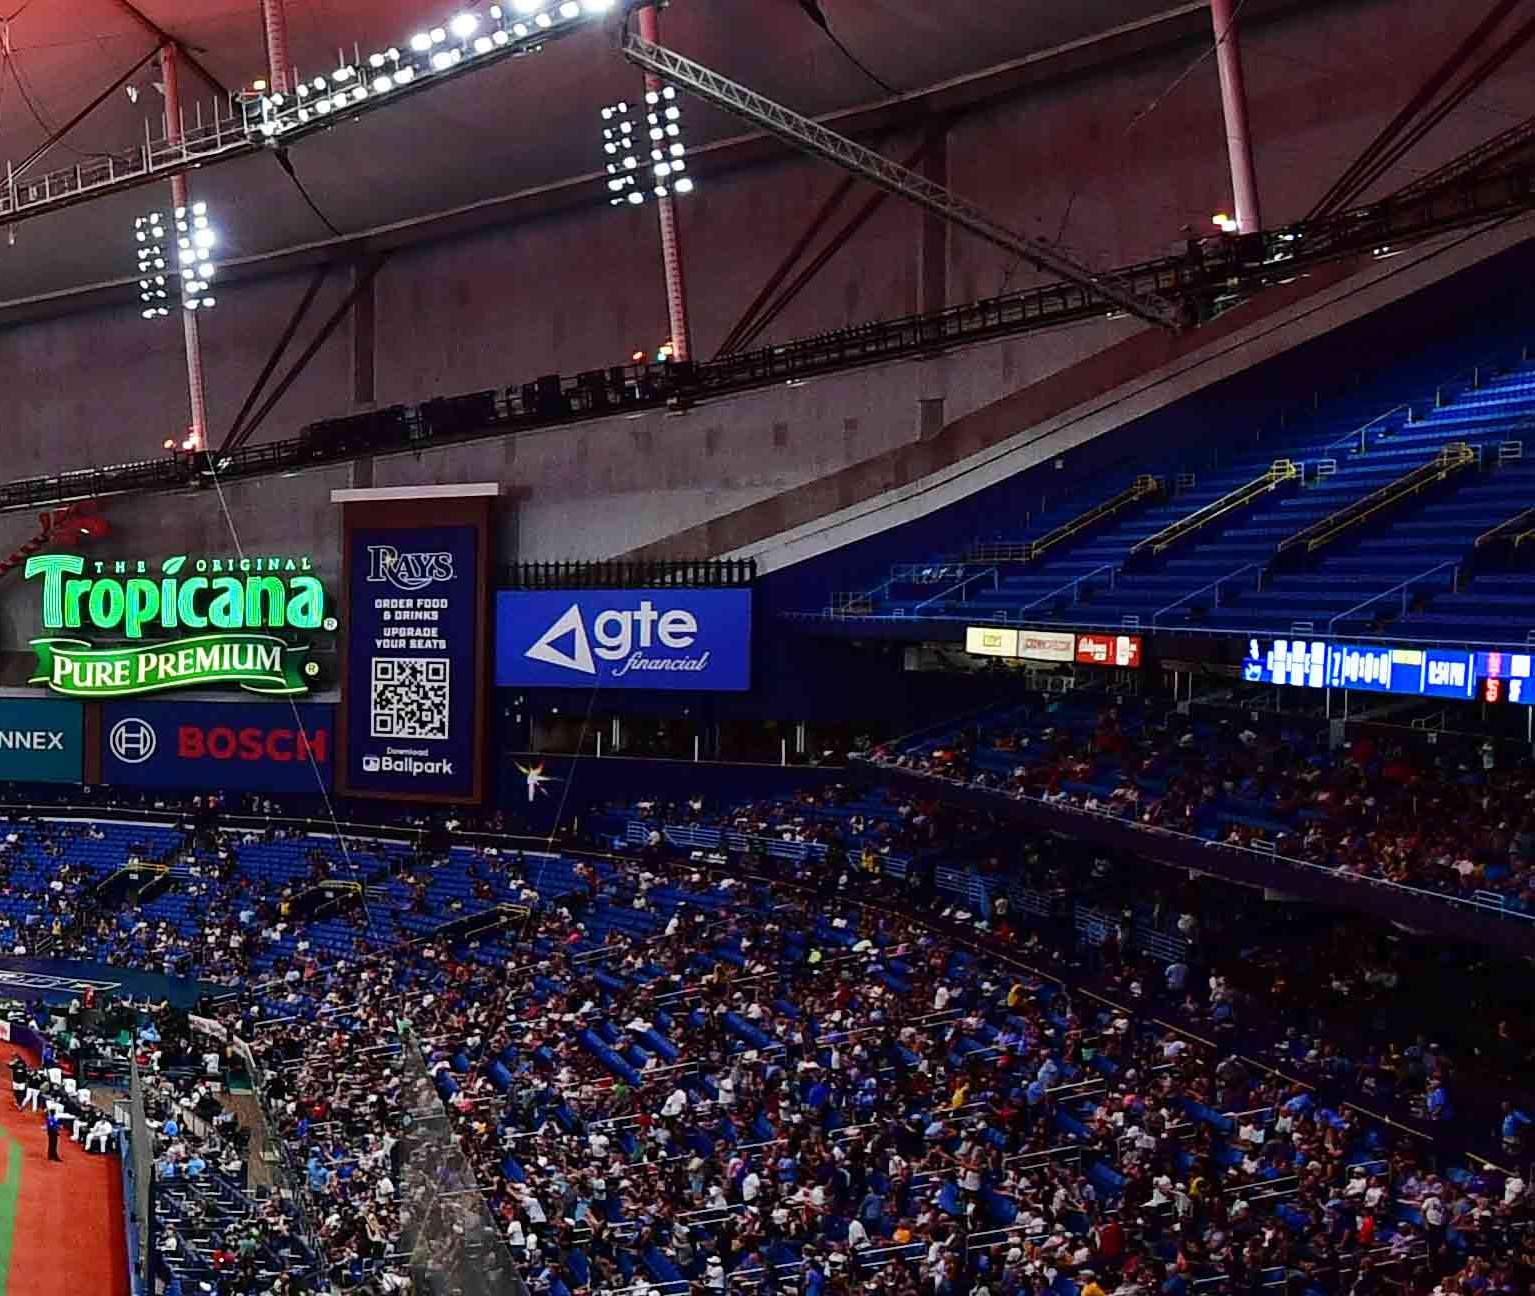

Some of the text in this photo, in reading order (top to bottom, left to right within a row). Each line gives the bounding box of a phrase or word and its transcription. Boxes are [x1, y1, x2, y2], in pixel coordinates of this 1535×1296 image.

[94, 556, 311, 573] THE ORIGINAL
[367, 545, 453, 590] RAYS
[25, 554, 324, 638] Tropicana
[375, 598, 448, 609] ORDER FOOD
[394, 610, 439, 621] DRINKS
[384, 627, 439, 638] UPGRADE
[594, 601, 698, 661] gte
[375, 638, 447, 650] YOUR SEATS
[53, 643, 282, 687] PURE PREMIUM
[612, 651, 711, 677] financial
[177, 724, 328, 763] BOSCH
[382, 757, 453, 775] Ballpark
